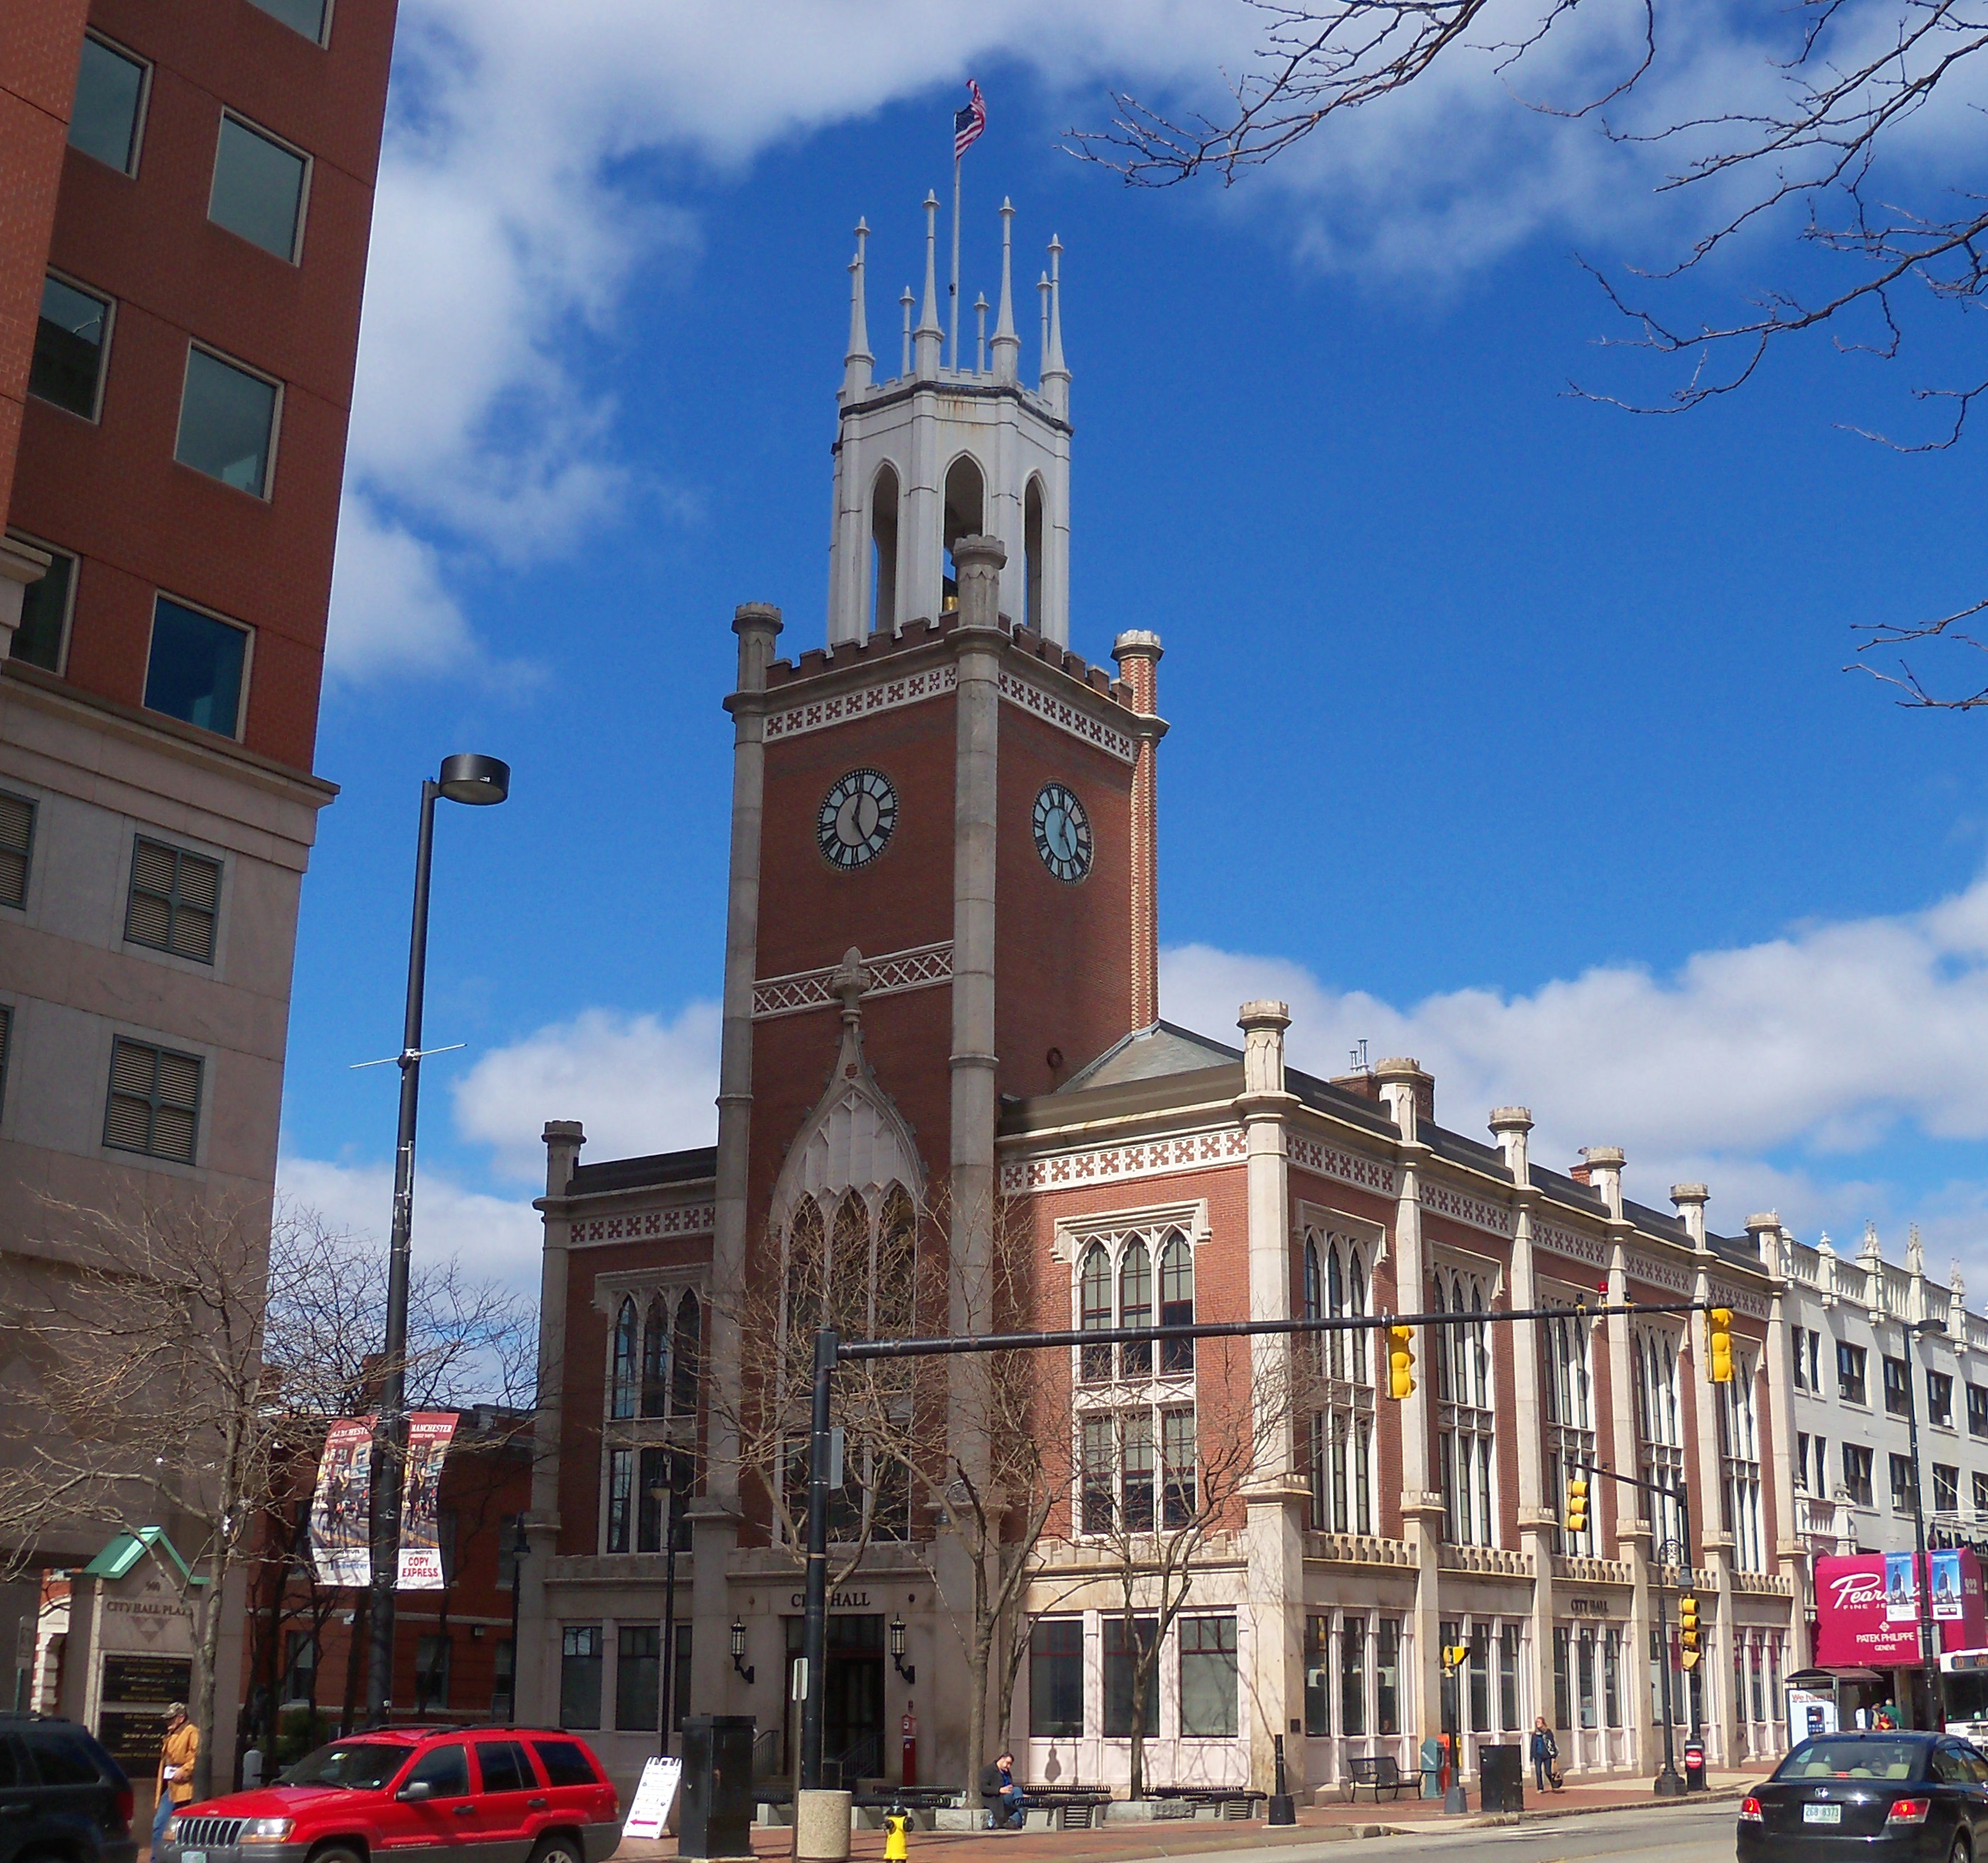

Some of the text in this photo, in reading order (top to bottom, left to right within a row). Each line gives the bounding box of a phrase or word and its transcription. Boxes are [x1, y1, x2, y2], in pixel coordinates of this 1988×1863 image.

[411, 1423, 453, 1433] MANCHESTER
[408, 1557, 429, 1567] COPY
[402, 1567, 439, 1578] EXPRESS
[831, 1592, 871, 1606] HALL
[106, 1601, 131, 1613] CITY
[133, 1602, 159, 1614] HALL
[1855, 1631, 1915, 1643] PATEK PHILIPPE
